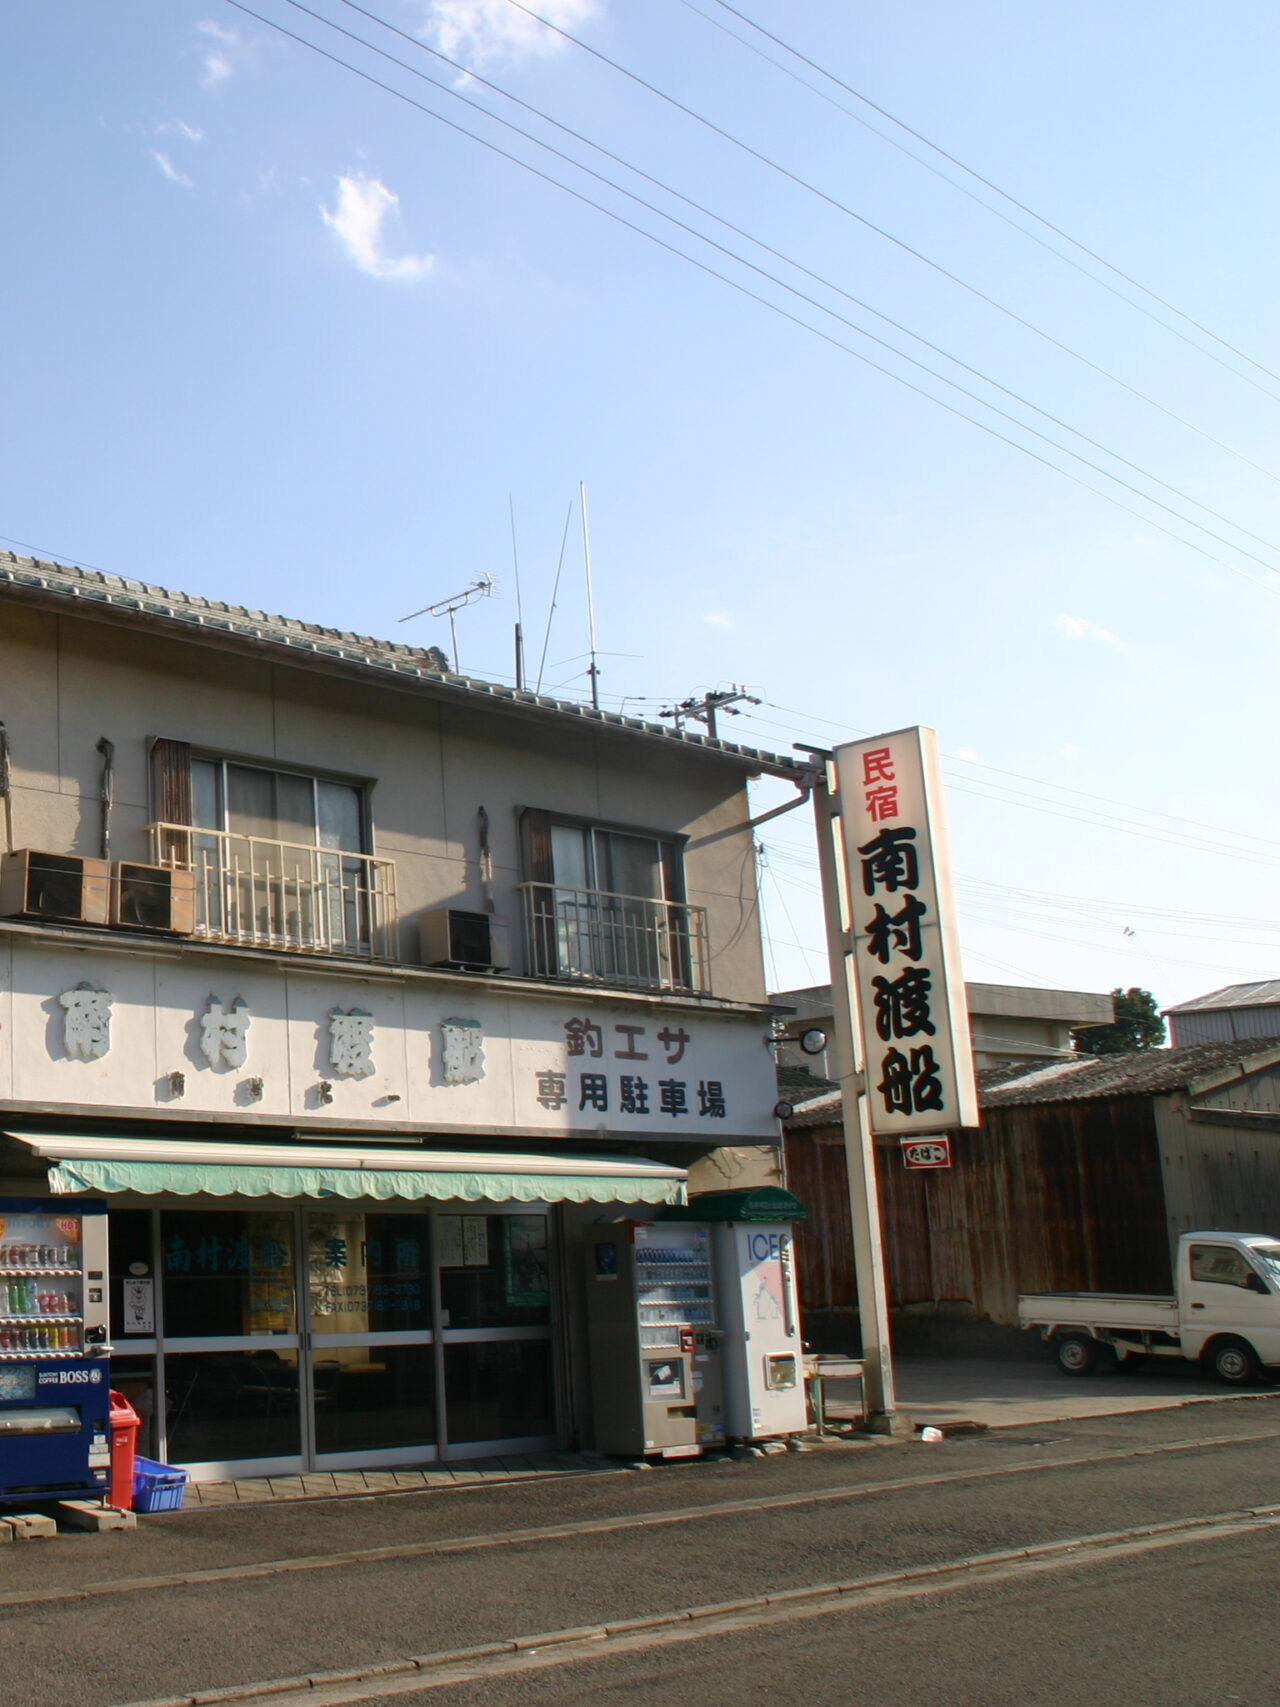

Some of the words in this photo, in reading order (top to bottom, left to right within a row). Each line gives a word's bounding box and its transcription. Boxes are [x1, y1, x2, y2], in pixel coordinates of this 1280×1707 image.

[862, 748, 899, 823] 民宿
[857, 826, 944, 1117] 南村渡船
[564, 1017, 690, 1065] 釣エサ
[535, 1069, 726, 1119] 専用駐車場
[59, 1370, 89, 1384] BOSS
